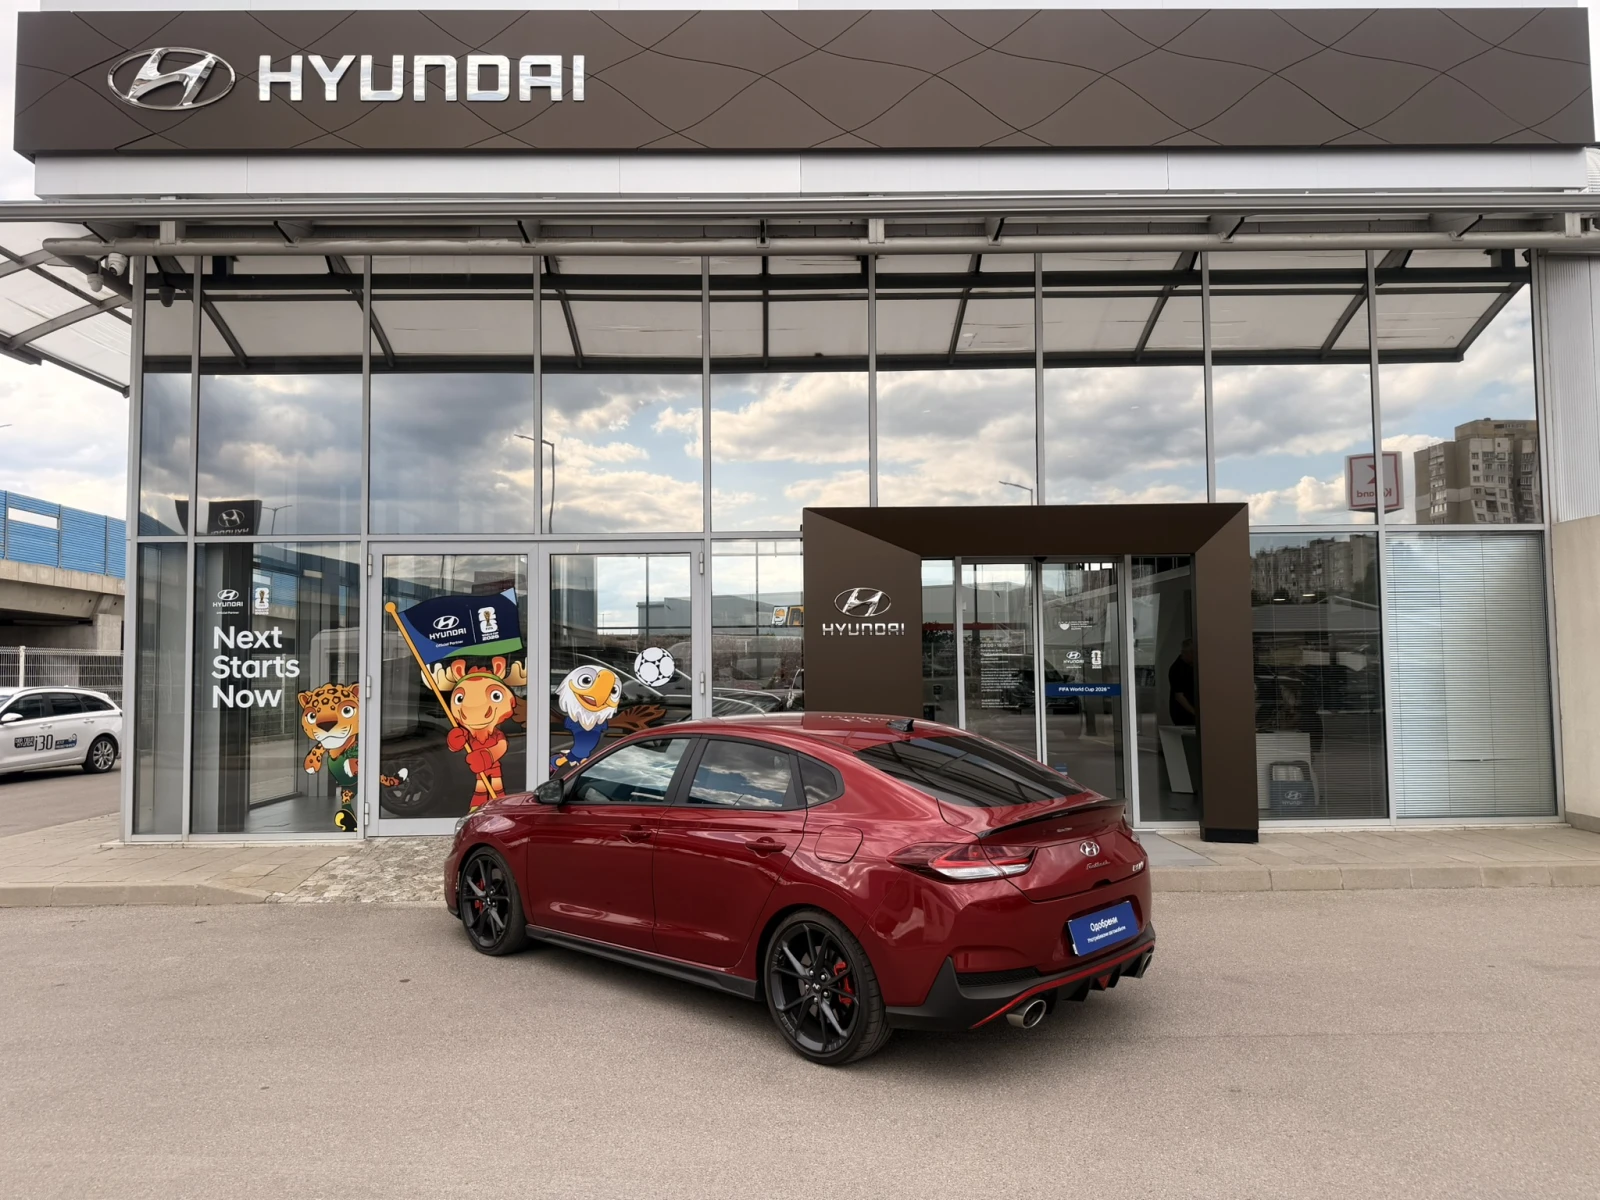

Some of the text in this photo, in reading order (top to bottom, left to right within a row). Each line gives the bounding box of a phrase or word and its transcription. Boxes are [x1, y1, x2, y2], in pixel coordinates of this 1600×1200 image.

[258, 54, 586, 102] HYUNDAI
[213, 625, 283, 649] Next
[428, 627, 467, 640] HYUNDAI
[822, 622, 905, 636] HYUNDAI
[211, 654, 300, 679] Starts
[212, 684, 283, 708] Now
[34, 733, 54, 751] i30
[1089, 916, 1118, 932] Одобрени
